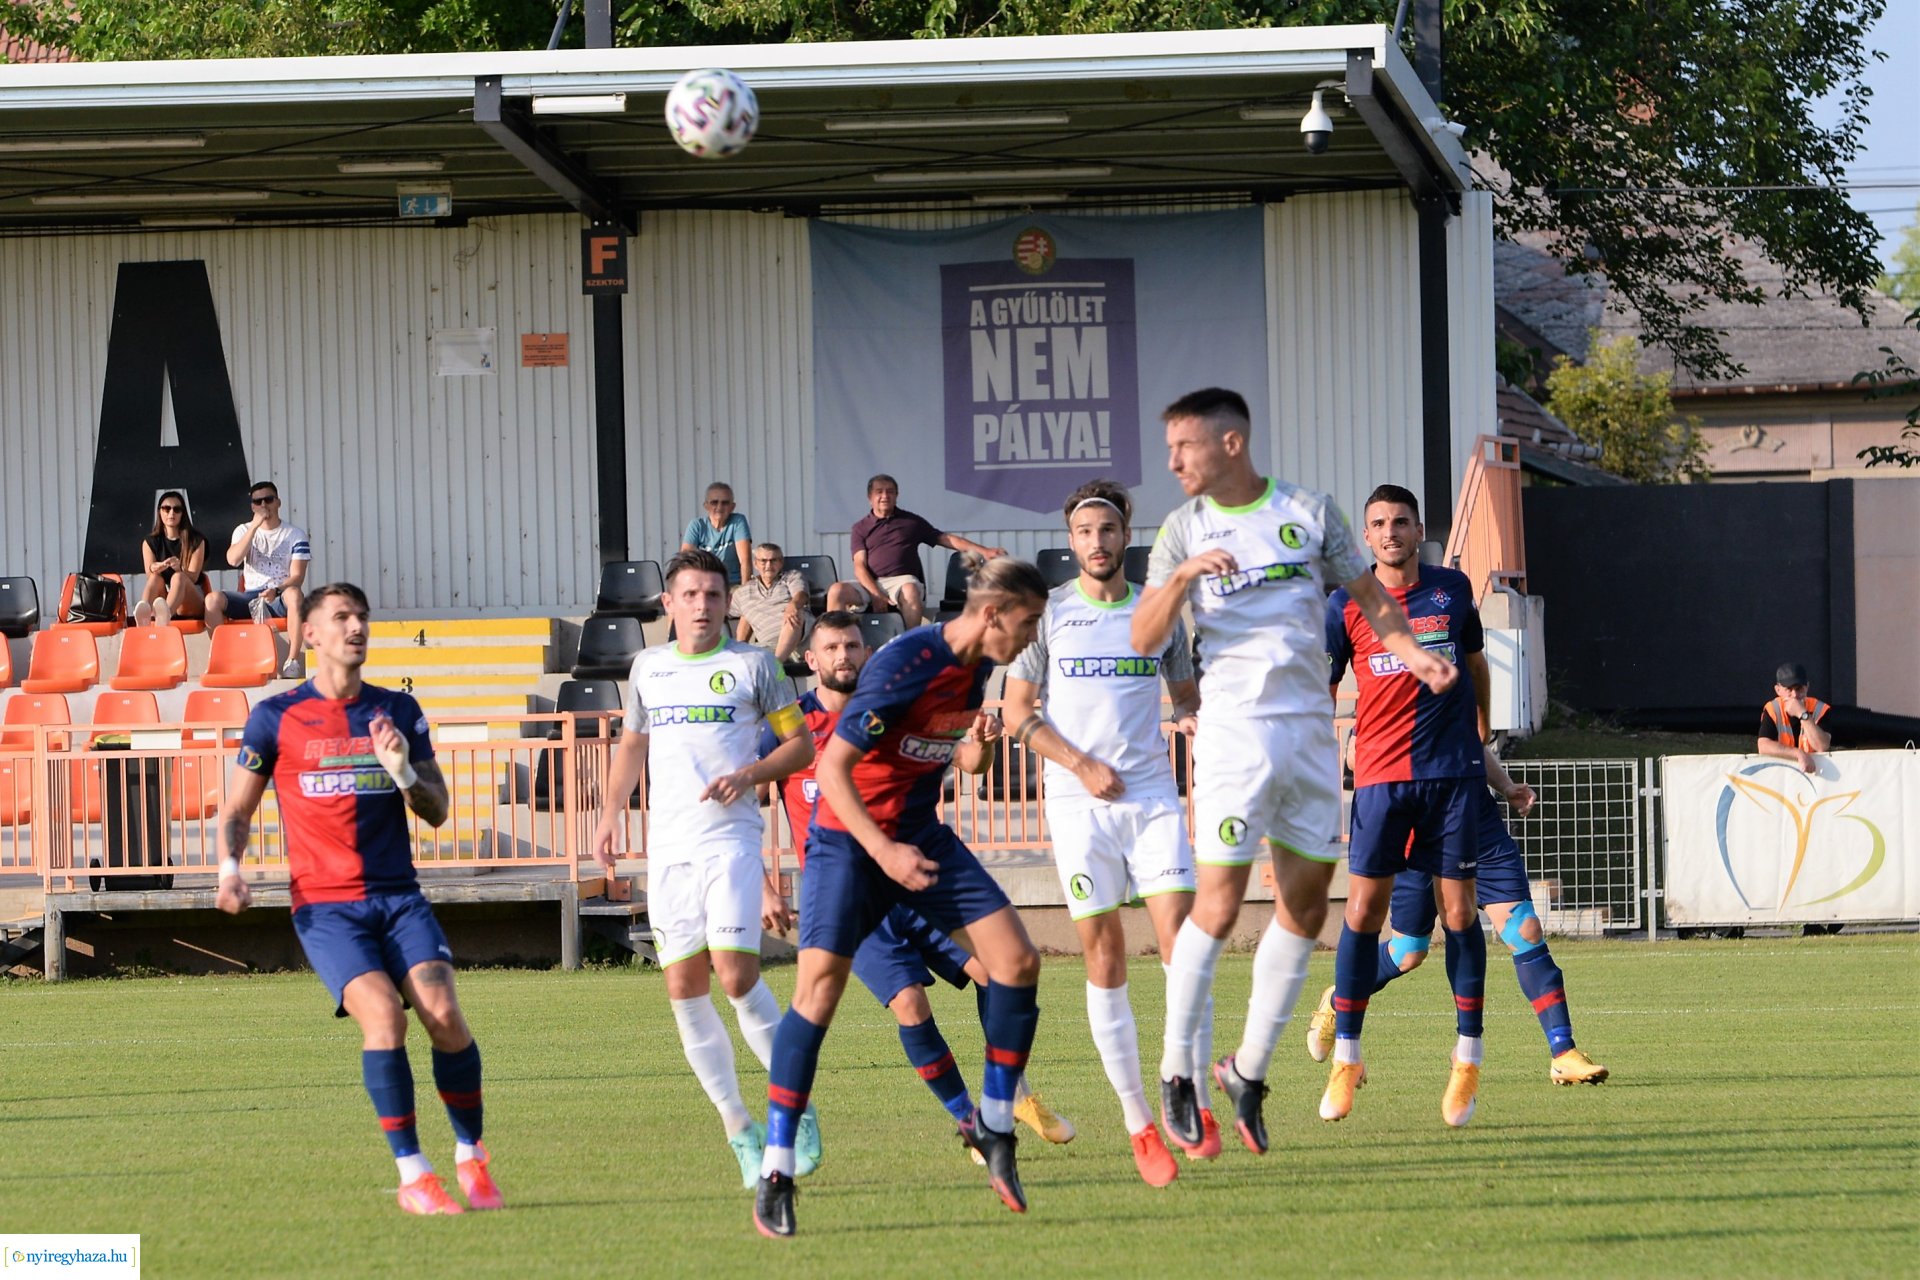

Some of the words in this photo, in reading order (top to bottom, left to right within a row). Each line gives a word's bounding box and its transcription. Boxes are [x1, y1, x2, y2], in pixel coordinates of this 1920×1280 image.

[591, 236, 619, 274] F
[585, 278, 625, 287] SZEKTOR
[970, 300, 987, 327] A
[991, 291, 1106, 326] GYŰLÖLET
[970, 326, 1110, 402] NEM
[82, 259, 252, 573] A
[973, 403, 1112, 462] PÁLYA!
[413, 628, 427, 646] 4
[401, 677, 413, 694] 3
